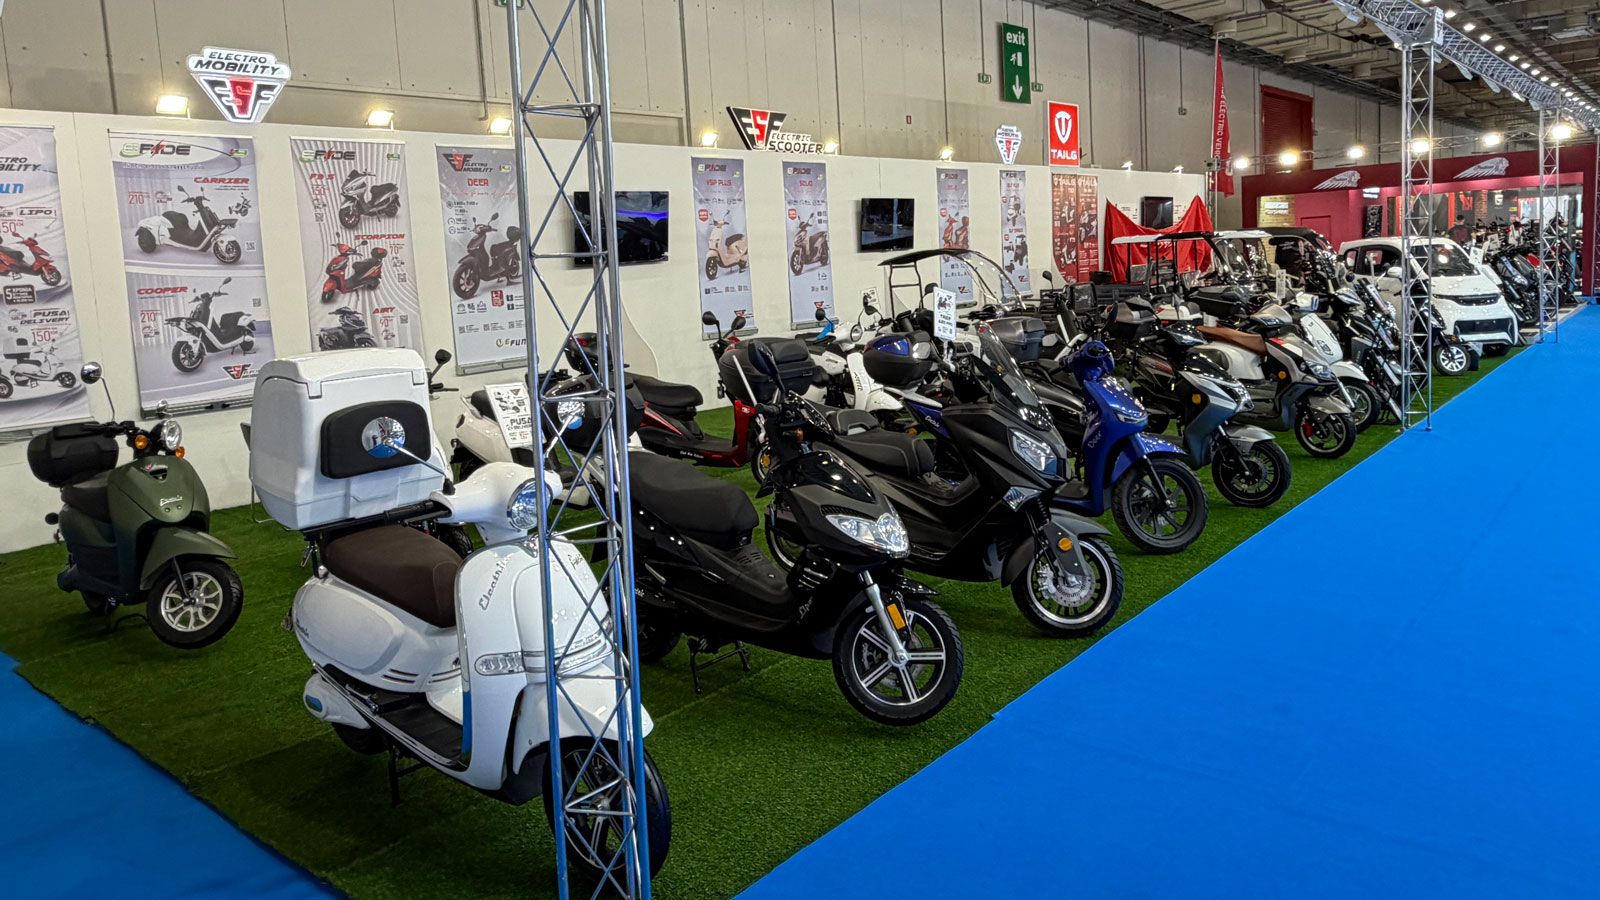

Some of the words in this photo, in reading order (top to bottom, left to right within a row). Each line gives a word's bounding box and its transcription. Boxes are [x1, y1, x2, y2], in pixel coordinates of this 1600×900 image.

[1006, 31, 1025, 46] exit
[208, 51, 267, 64] ELECTRO
[194, 60, 280, 76] MOBILITY
[1218, 100, 1226, 136] ELECTRIC
[772, 133, 811, 142] ELECTRIC
[768, 141, 823, 153] SCOOTER
[1050, 149, 1077, 160] TAILG
[467, 178, 489, 187] DEER
[128, 193, 145, 204] 210
[354, 233, 405, 241] SCORPION
[5, 288, 13, 300] 5
[137, 286, 188, 295] COOPER
[33, 310, 67, 318] PUSA
[372, 307, 396, 315] AIRY
[20, 317, 70, 325] DELIVERY
[141, 312, 156, 323] 210
[32, 331, 50, 342] 150
